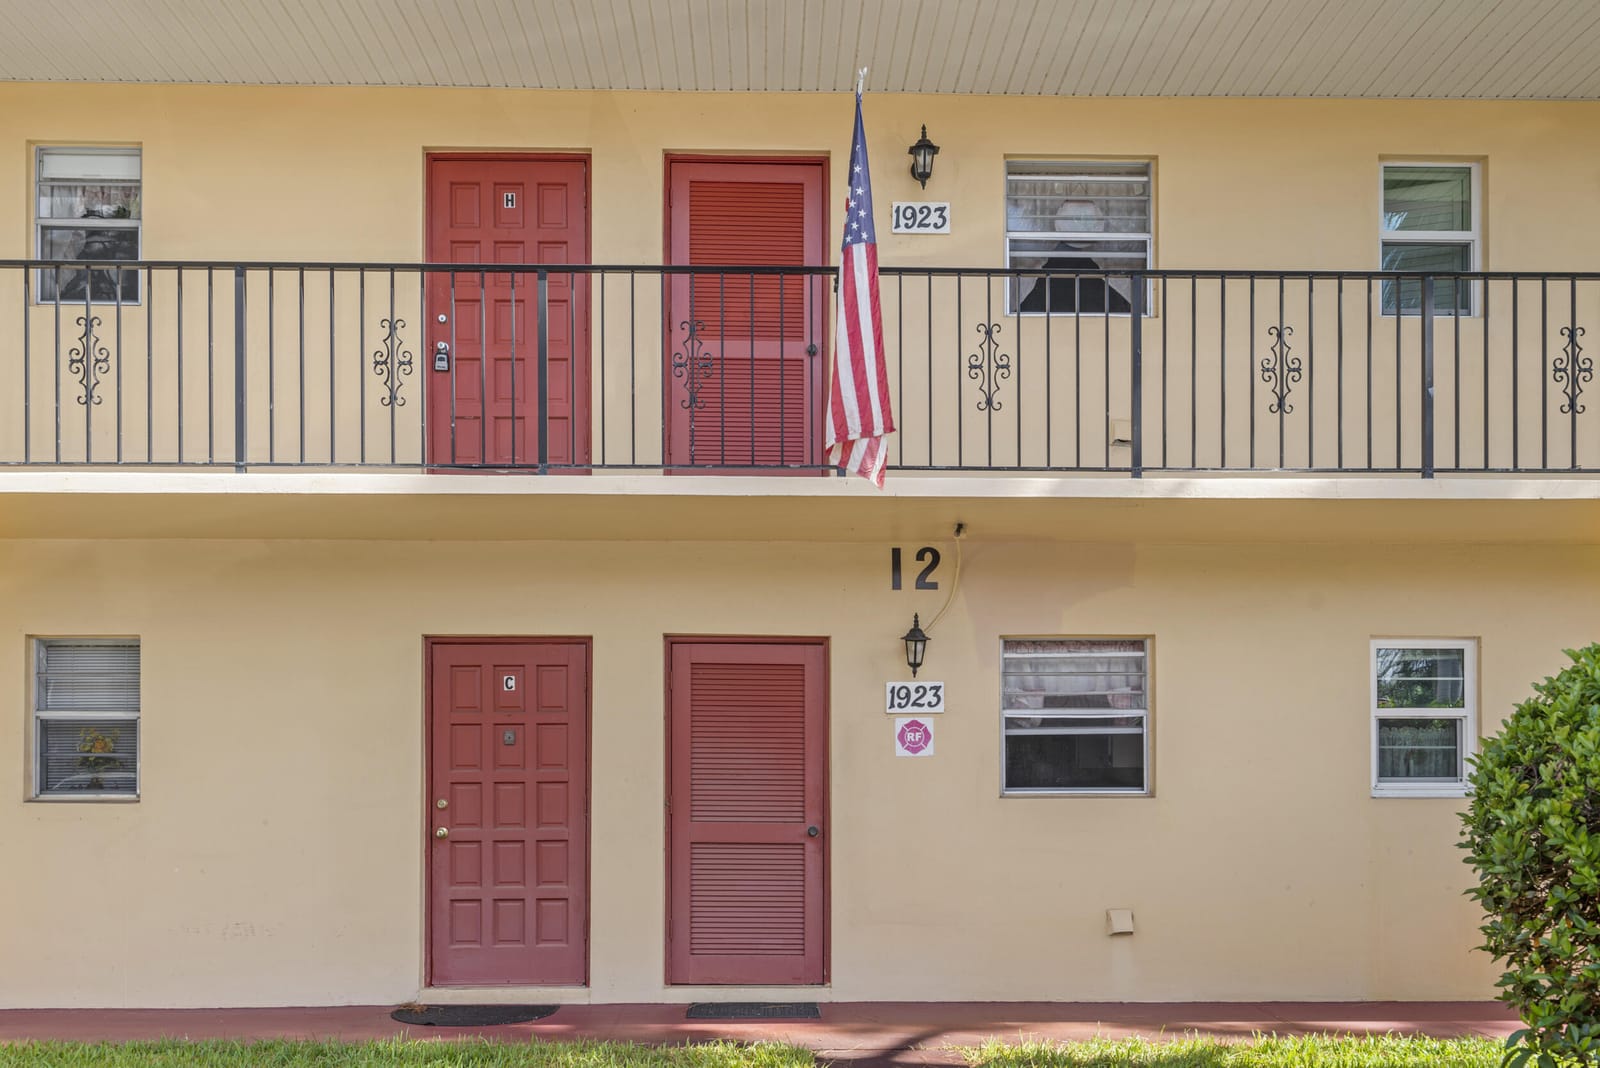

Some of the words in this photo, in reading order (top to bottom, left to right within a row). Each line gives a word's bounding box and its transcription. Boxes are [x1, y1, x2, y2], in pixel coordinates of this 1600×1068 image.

[505, 193, 515, 207] H
[894, 205, 947, 229] 1923
[892, 546, 941, 590] 12
[504, 676, 514, 690] C
[888, 685, 942, 709] 1923
[907, 732, 922, 742] RF
